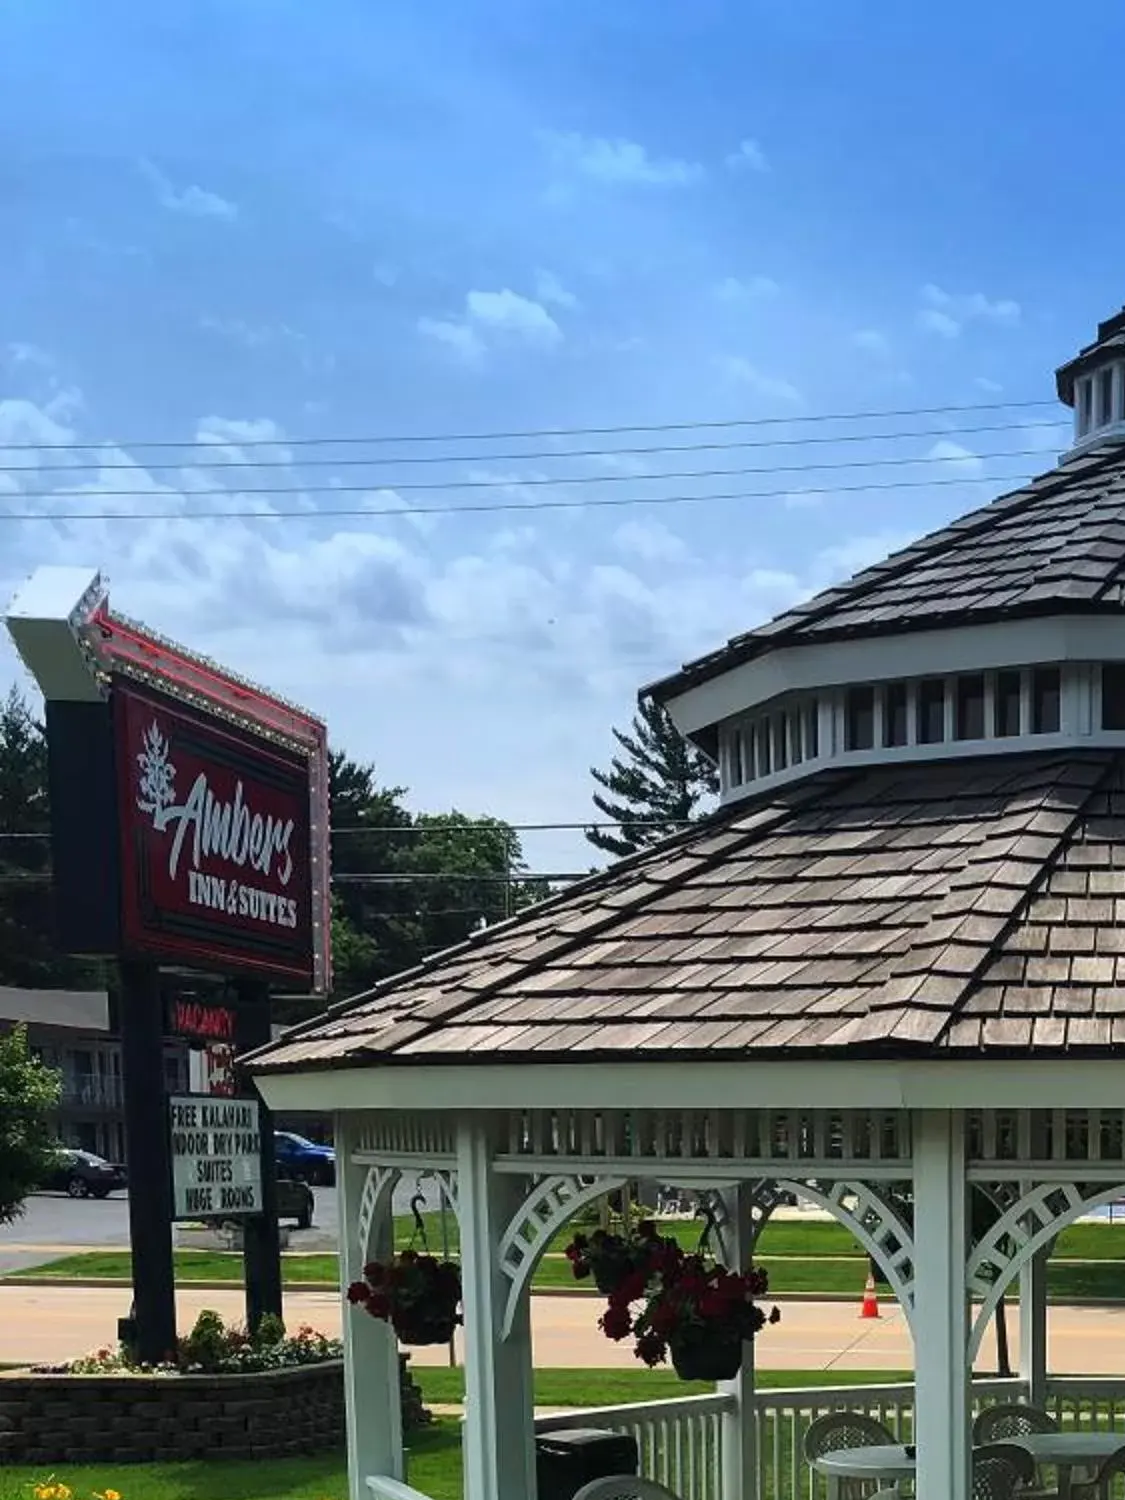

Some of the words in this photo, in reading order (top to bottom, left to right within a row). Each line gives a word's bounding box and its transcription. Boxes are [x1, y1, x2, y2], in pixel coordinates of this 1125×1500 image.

[169, 772, 294, 886] Ambers
[188, 870, 226, 911] INN
[238, 885, 298, 928] SUITES
[172, 1104, 197, 1128] FREE
[213, 1132, 234, 1156] DRY
[197, 1159, 233, 1182] SUITES
[186, 1187, 213, 1213] HUGE
[220, 1184, 255, 1209] ROOMS
